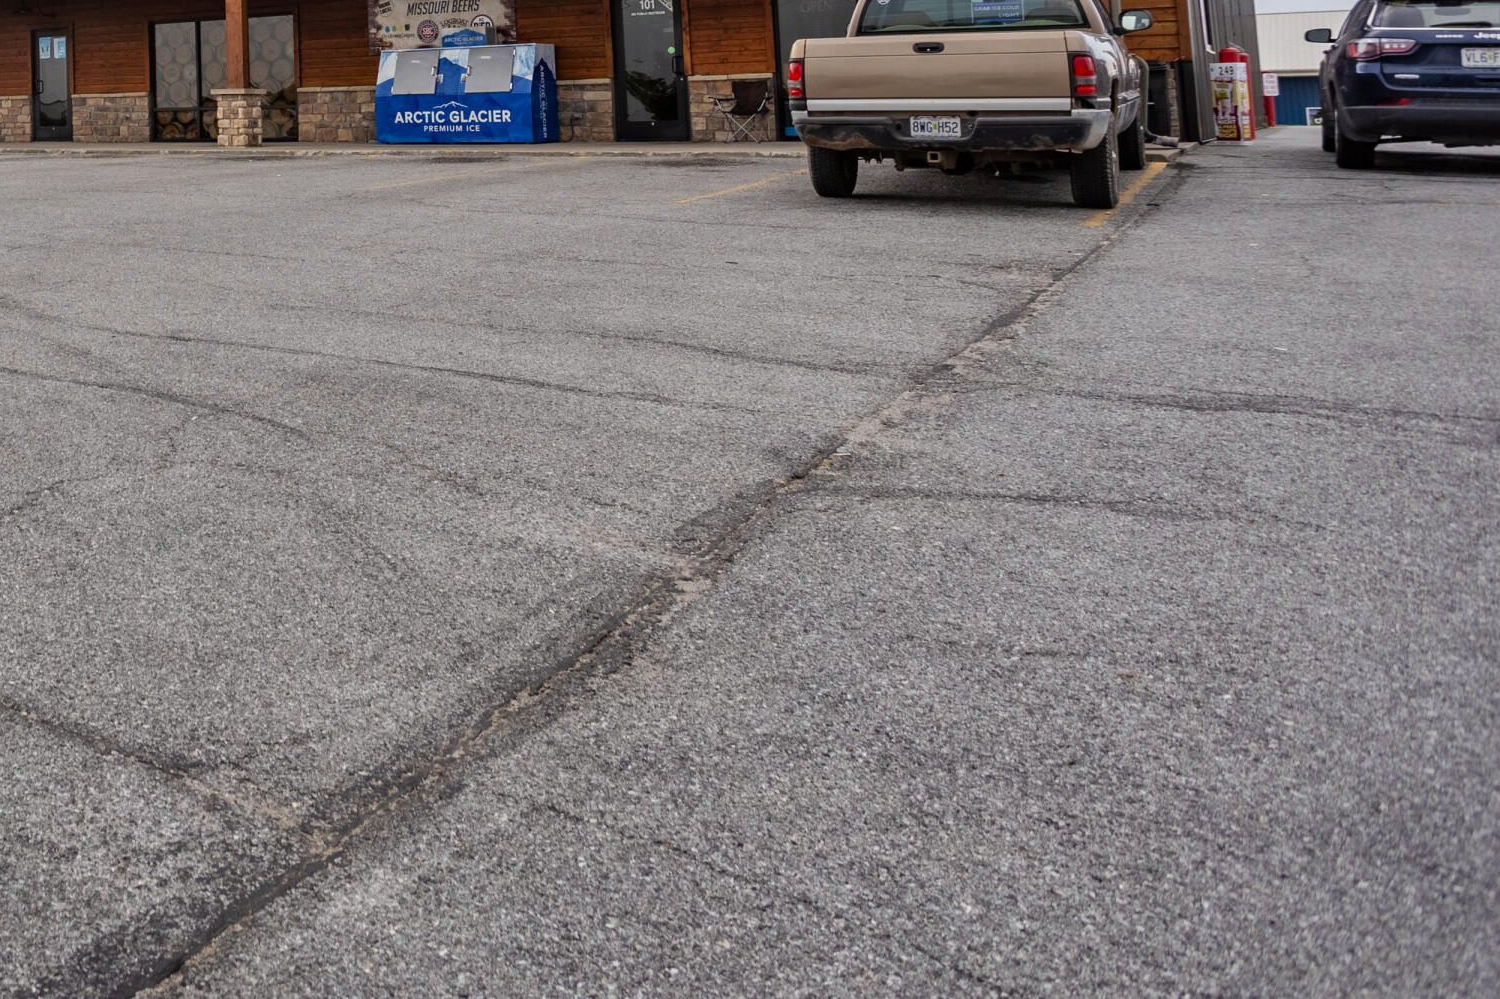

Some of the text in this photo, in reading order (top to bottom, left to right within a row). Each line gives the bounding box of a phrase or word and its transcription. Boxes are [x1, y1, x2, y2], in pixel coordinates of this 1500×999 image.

[406, 0, 449, 16] MISSOURI
[639, 0, 655, 10] 101
[394, 110, 511, 124] ARCTIC GLACIER
